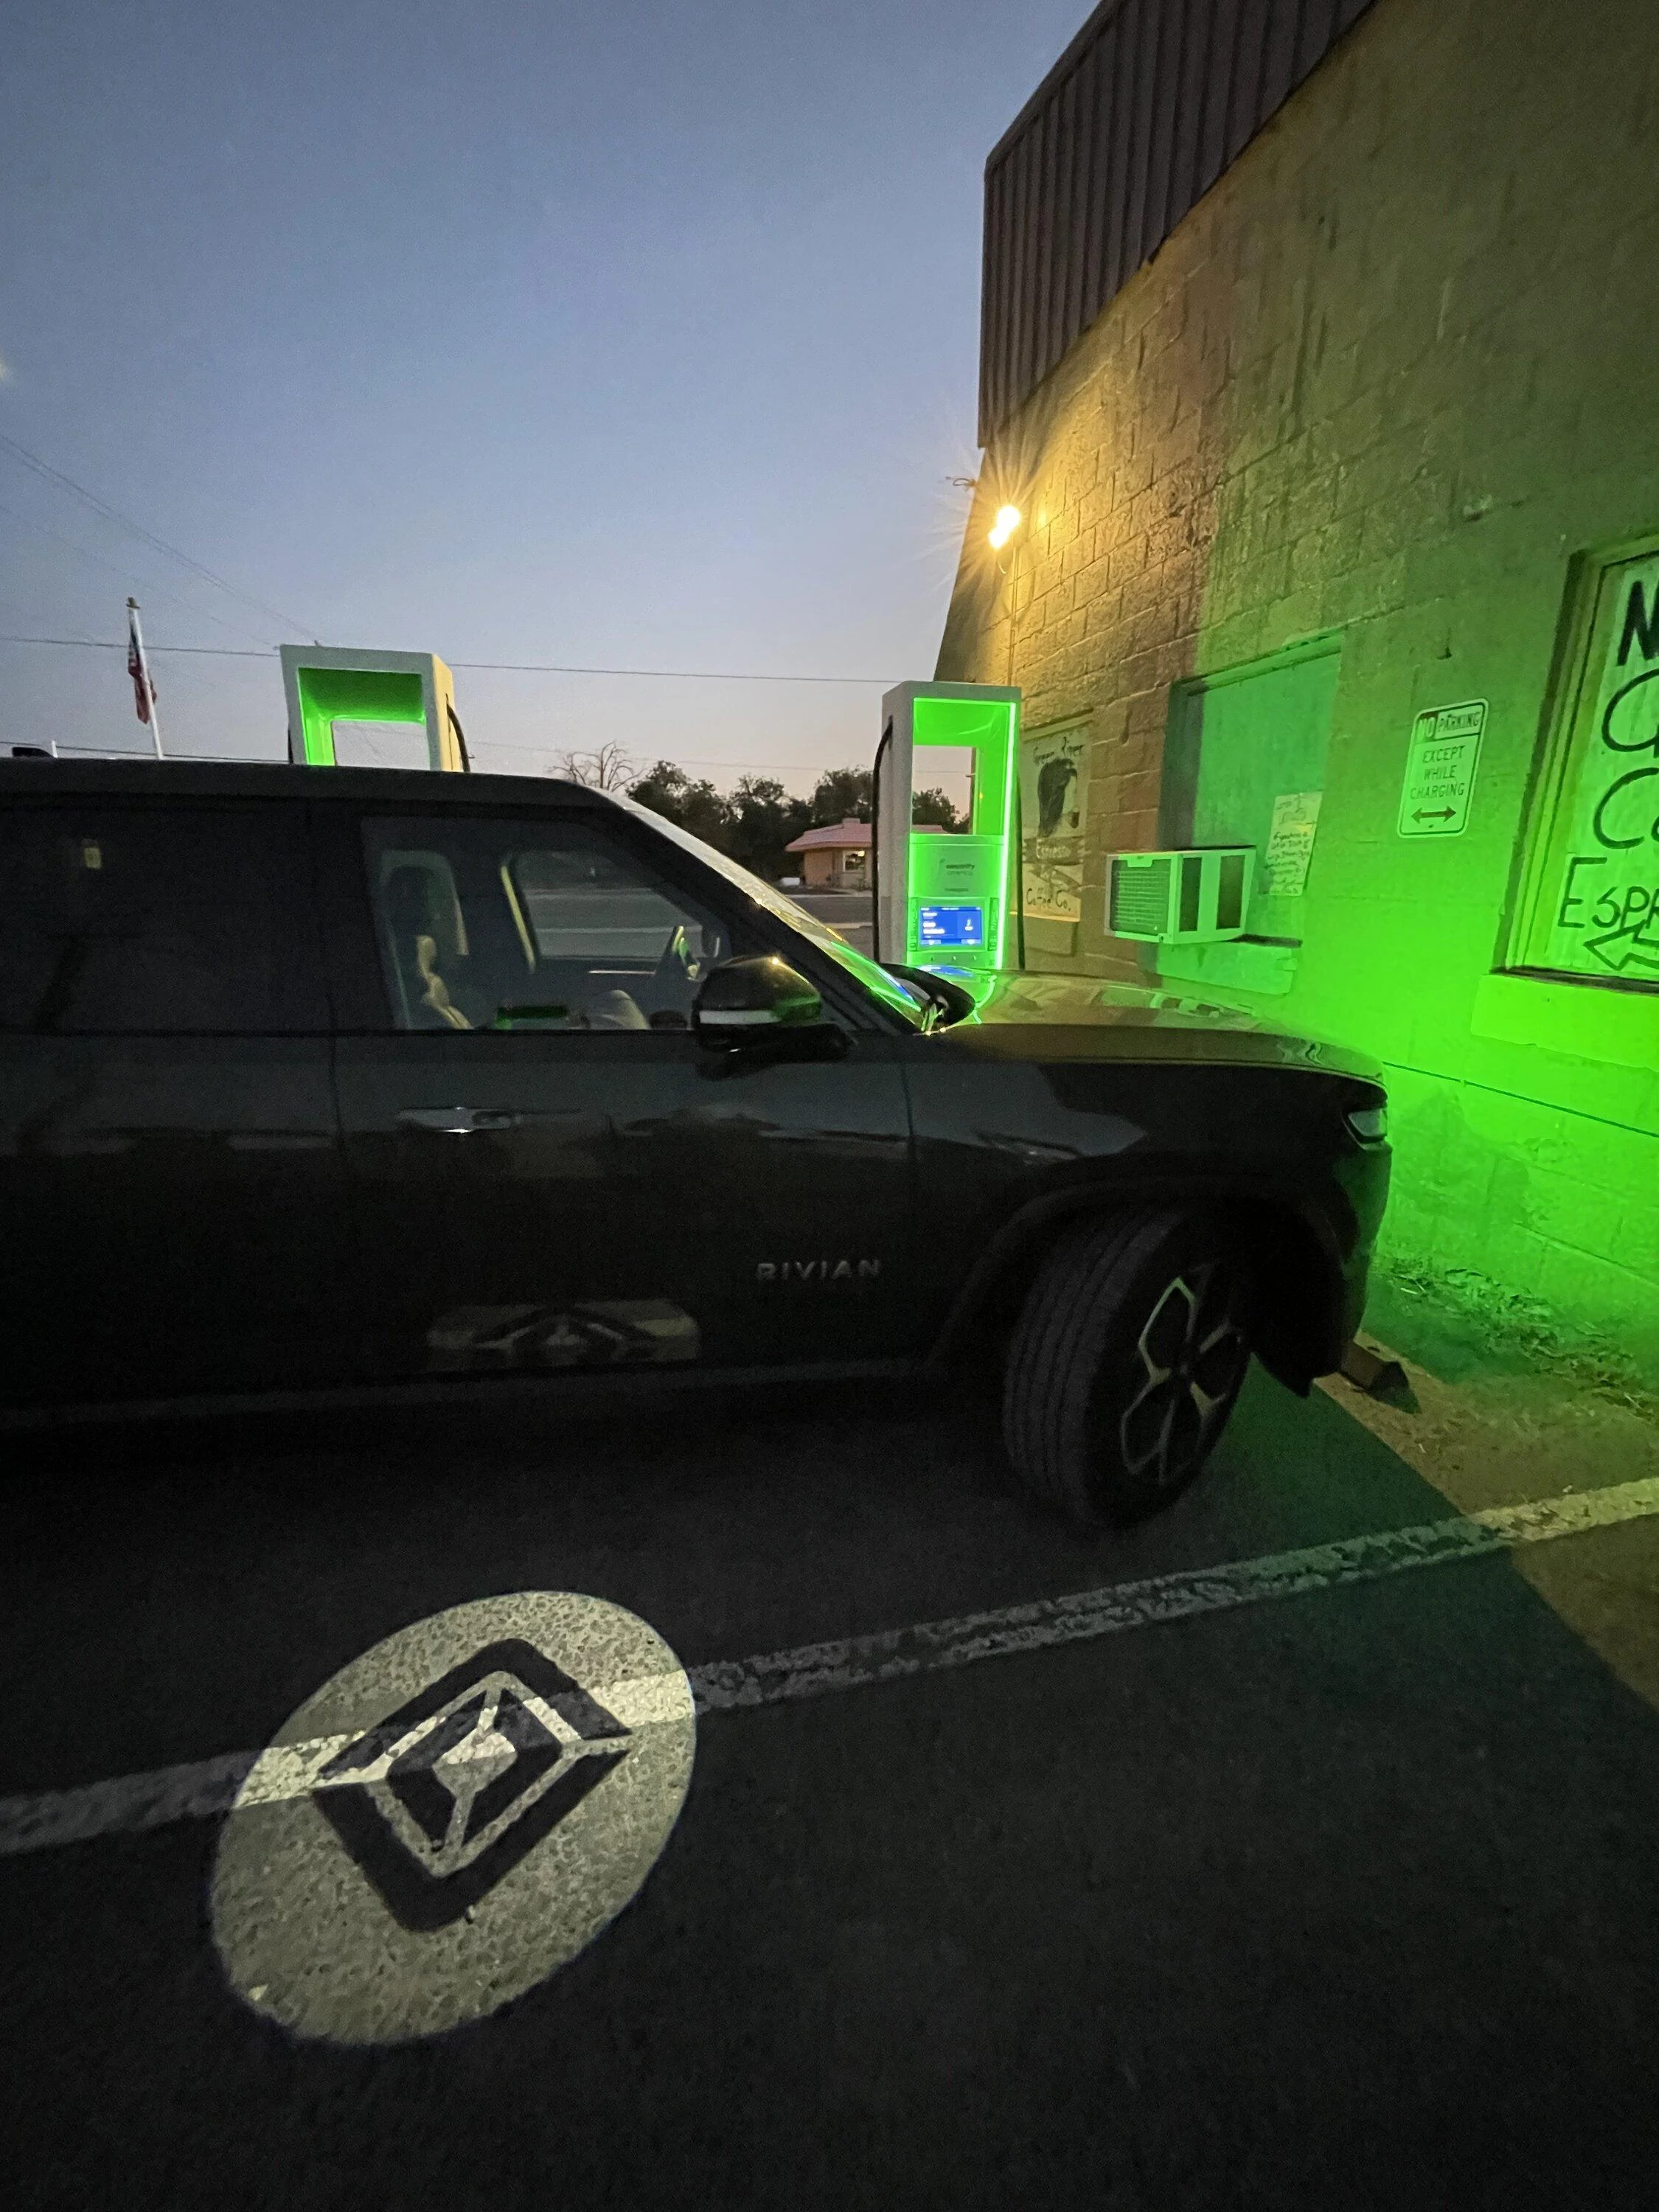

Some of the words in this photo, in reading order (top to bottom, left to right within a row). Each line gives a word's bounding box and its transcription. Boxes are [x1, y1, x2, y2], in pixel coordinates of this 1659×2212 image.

[1416, 717, 1436, 740] NO
[1438, 711, 1481, 732] PARKING
[1422, 745, 1466, 763] EXCEPT
[1424, 765, 1458, 781] WHILE
[1410, 782, 1465, 800] CHARGING
[757, 1259, 882, 1281] RIVIAN
